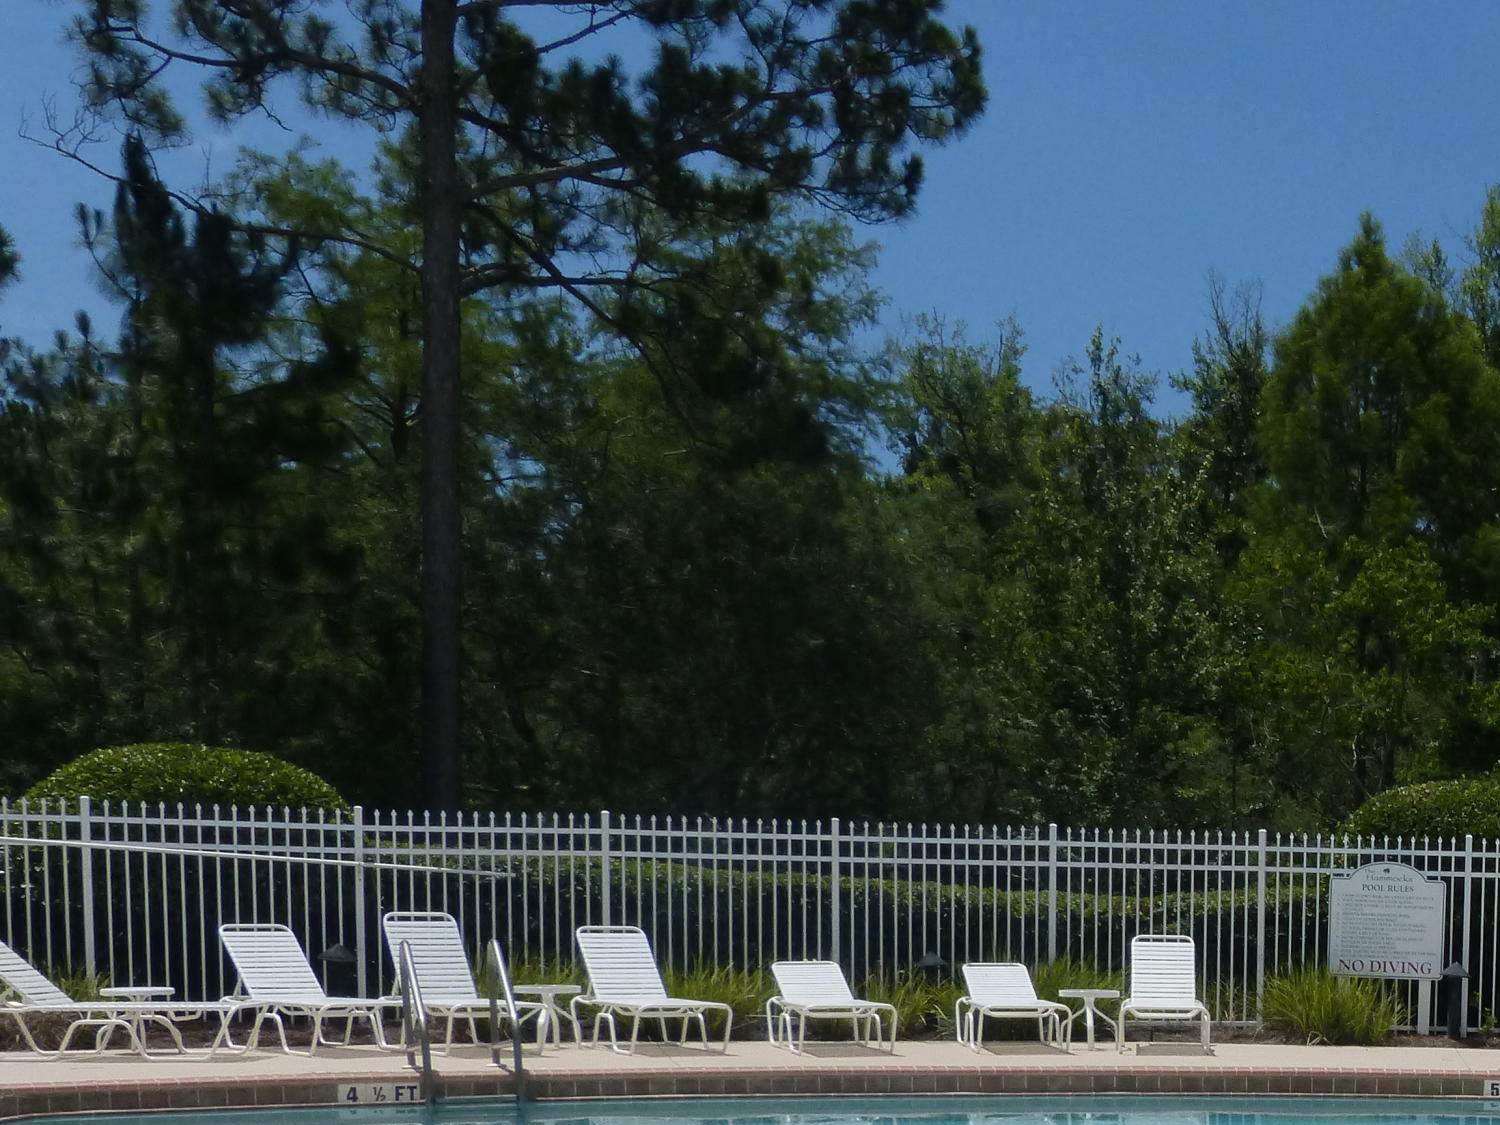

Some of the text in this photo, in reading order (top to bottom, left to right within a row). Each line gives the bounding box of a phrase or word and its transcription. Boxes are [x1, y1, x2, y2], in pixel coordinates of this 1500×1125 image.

[1362, 883, 1415, 893] POOL RULES
[1339, 959, 1432, 975] NO DIVING
[346, 1087, 358, 1102] 4
[395, 1086, 417, 1101] FT
[1490, 1083, 1499, 1096] 5
